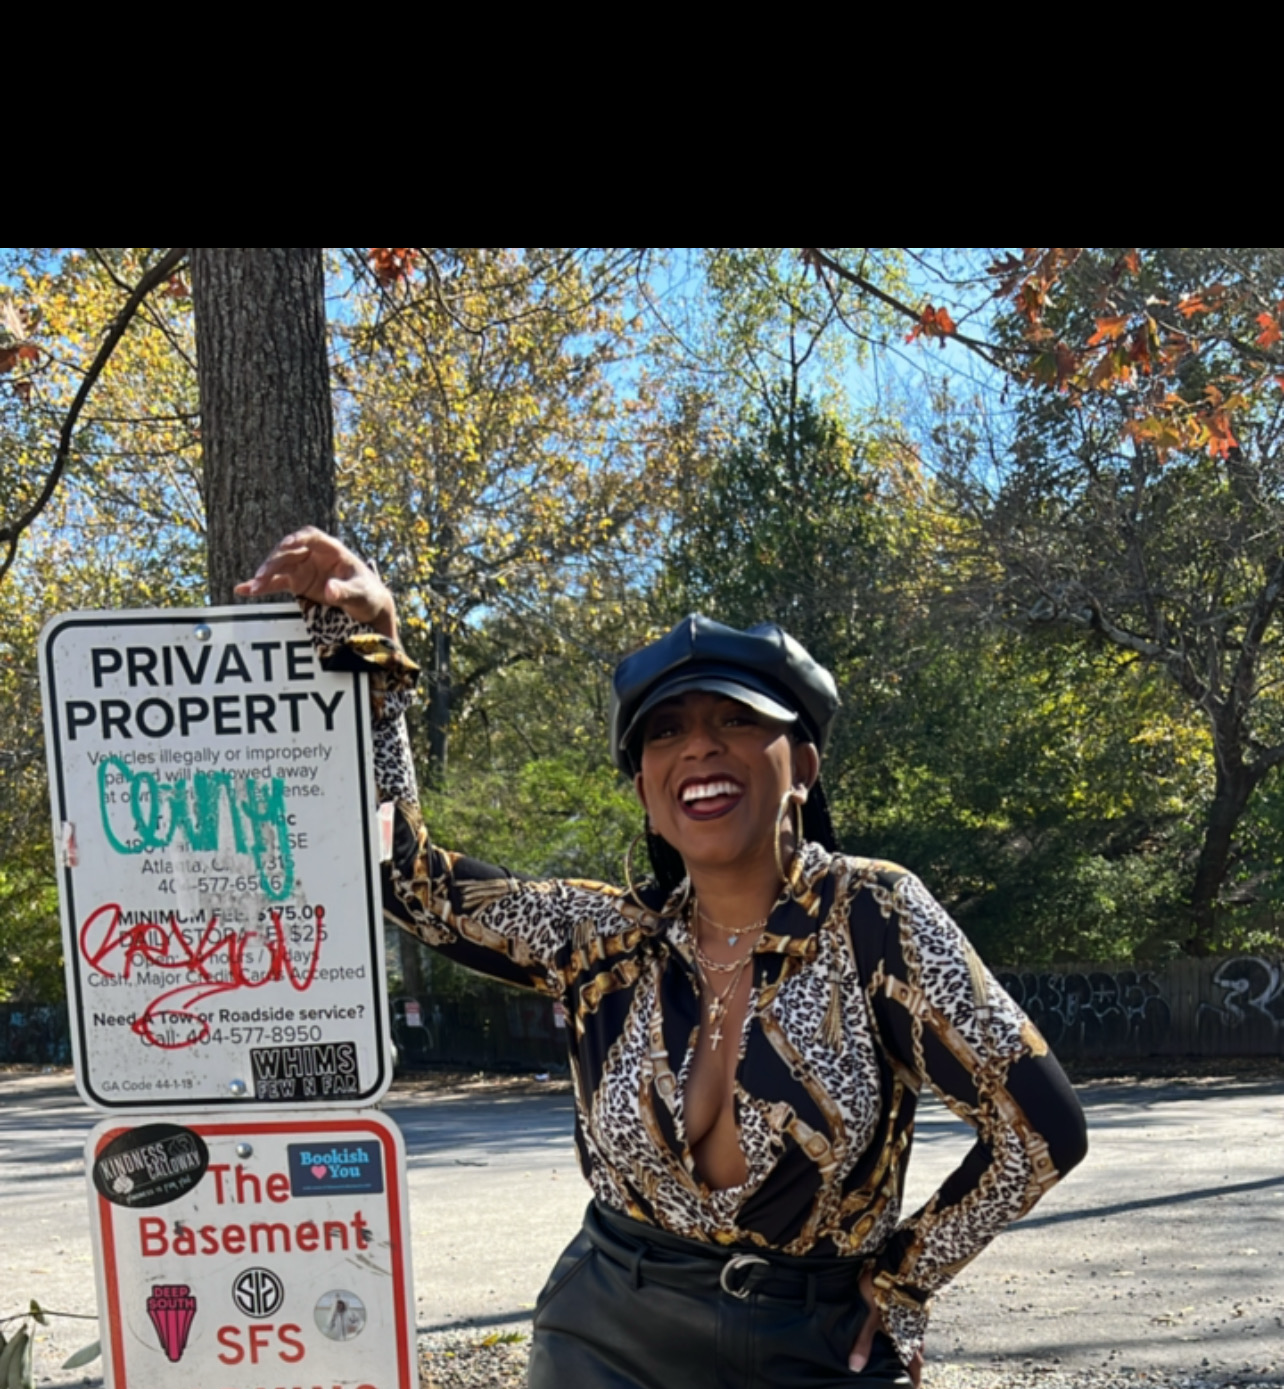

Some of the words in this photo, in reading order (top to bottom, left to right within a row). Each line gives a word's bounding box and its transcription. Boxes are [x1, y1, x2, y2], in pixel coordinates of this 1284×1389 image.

[91, 640, 316, 689] PRIVATE
[65, 690, 346, 741] PROPERTY
[160, 746, 220, 766] illegally
[224, 748, 241, 761] or
[245, 742, 333, 762] improperly
[165, 766, 192, 782] will
[219, 764, 272, 780] towed
[275, 765, 319, 781] away
[118, 929, 174, 948] DAILY
[209, 947, 254, 964] hours
[283, 945, 320, 964] days
[87, 971, 132, 990] Cash,
[136, 970, 181, 989] Major
[185, 966, 234, 984] Credit
[239, 967, 285, 983] Cards
[289, 963, 366, 982] Accepted
[92, 1011, 137, 1027] Need
[160, 1010, 194, 1026] Tow
[197, 1011, 215, 1024] or
[218, 1007, 295, 1024] Roadside
[299, 1003, 366, 1020] service?
[140, 1027, 181, 1048] Call:
[187, 1024, 322, 1046] 404-577-8950
[252, 1044, 356, 1080] WHIMS
[101, 1080, 120, 1093] GA
[121, 1079, 152, 1092] Code
[256, 1077, 297, 1100] FEW
[302, 1075, 318, 1096] N
[321, 1074, 359, 1096] FAR
[99, 1141, 169, 1181] KINDNESS
[146, 1150, 201, 1181] CALLOWAY
[299, 1146, 370, 1167] Bookish
[328, 1164, 362, 1179] You
[206, 1163, 291, 1205] The
[138, 1210, 370, 1258] Basement
[153, 1286, 189, 1297] DEEP
[148, 1298, 195, 1310] SOUTH
[216, 1323, 306, 1366] SFS
